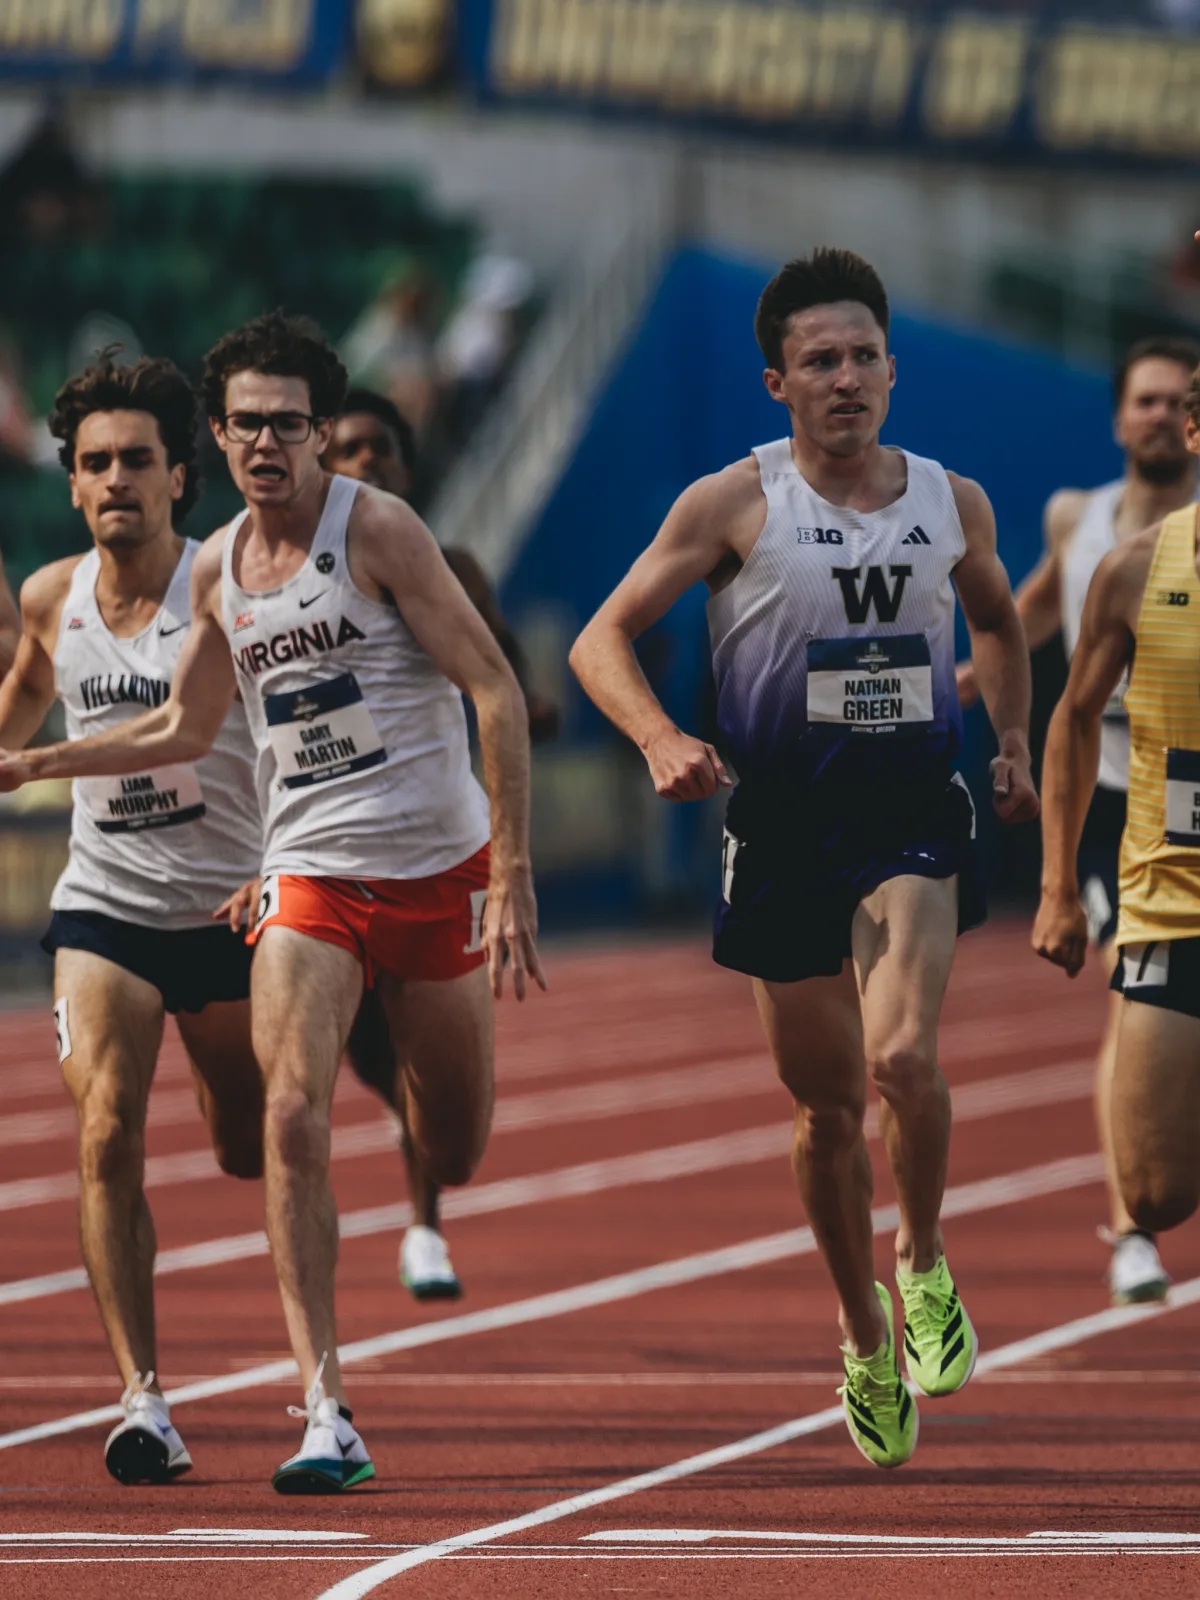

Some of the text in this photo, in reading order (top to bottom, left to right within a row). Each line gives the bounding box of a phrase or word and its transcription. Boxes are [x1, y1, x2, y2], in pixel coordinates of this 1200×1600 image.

[830, 563, 913, 626] W
[234, 615, 367, 676] VIRGINIA
[844, 678, 902, 697] NATHAN
[843, 698, 903, 721] GREEN
[299, 723, 333, 745] GARY
[294, 735, 358, 770] MARTIN
[120, 773, 155, 795] LIAM
[107, 787, 179, 818] MURPHY
